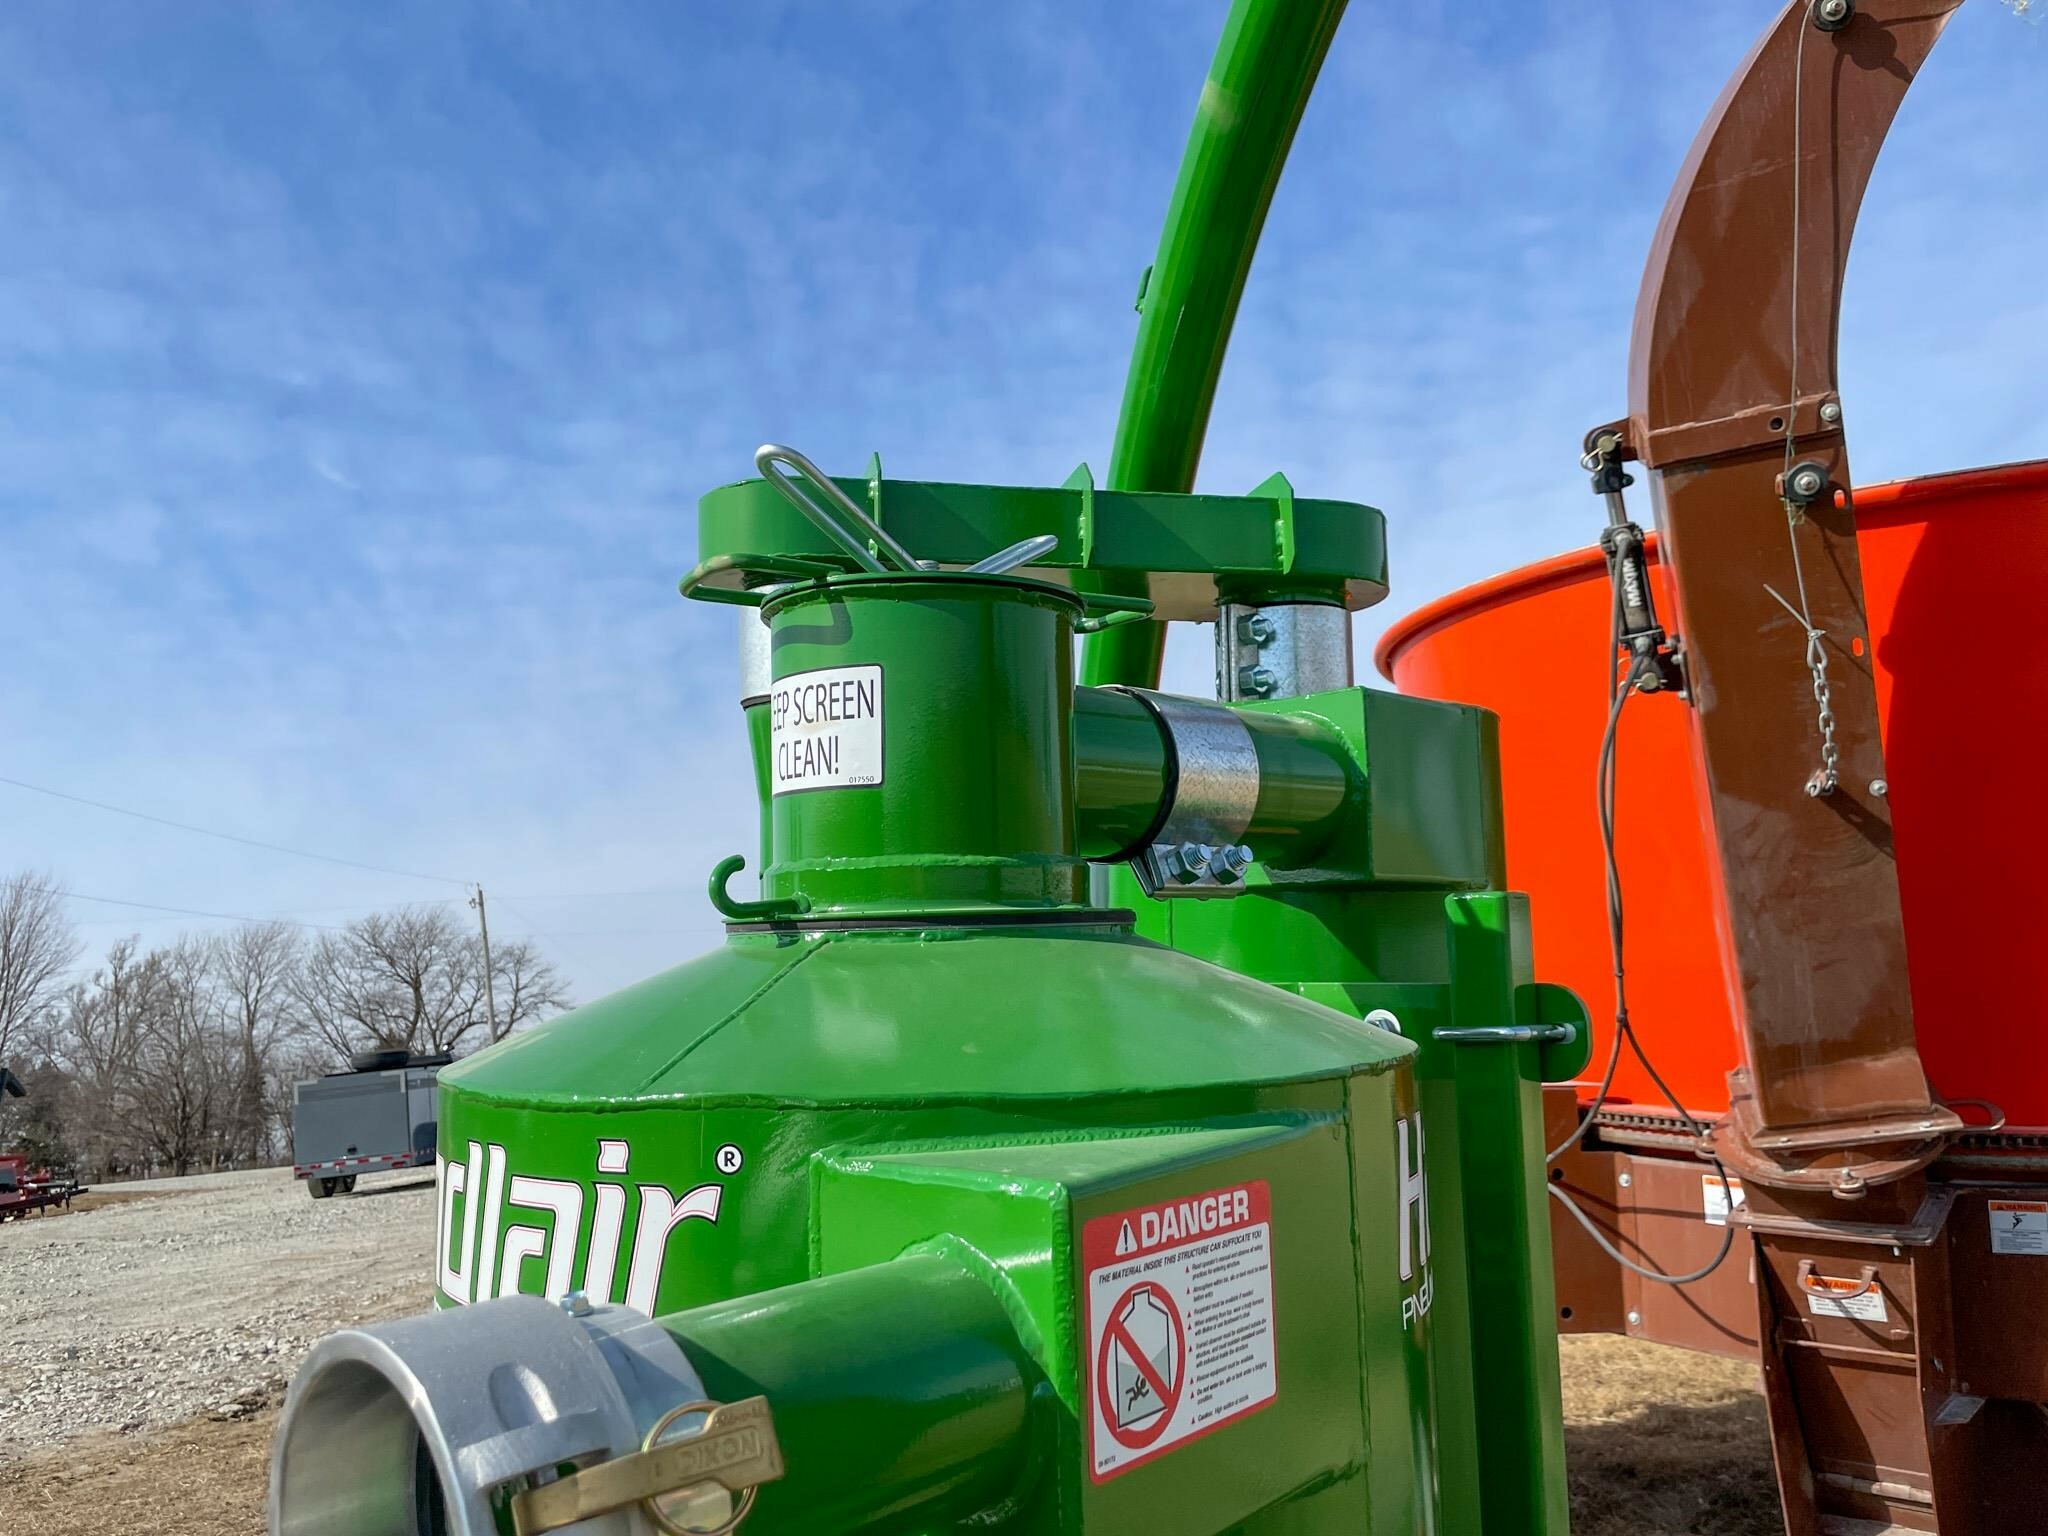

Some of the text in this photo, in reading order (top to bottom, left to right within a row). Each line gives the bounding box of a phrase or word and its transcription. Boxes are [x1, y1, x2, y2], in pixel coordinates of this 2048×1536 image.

[1623, 557, 1642, 608] MAXIM
[772, 679, 875, 732] EEP SCREEN
[778, 735, 839, 781] CLEAN!
[849, 776, 875, 784] 017550
[435, 1137, 724, 1319] dlair
[1140, 1188, 1250, 1249] DANGER
[1098, 1272, 1110, 1285] THE
[1112, 1263, 1143, 1281] MATERIAL
[1143, 1258, 1163, 1272] INSIDE
[1164, 1253, 1177, 1267] THIS
[1177, 1244, 1209, 1263] STRUCTURE
[1209, 1241, 1222, 1254] CAN
[1222, 1233, 1251, 1250] SUFFOCATE
[1251, 1229, 1262, 1241] YOU
[1402, 1264, 1434, 1331] PNEU
[676, 1428, 761, 1474] DIXON
